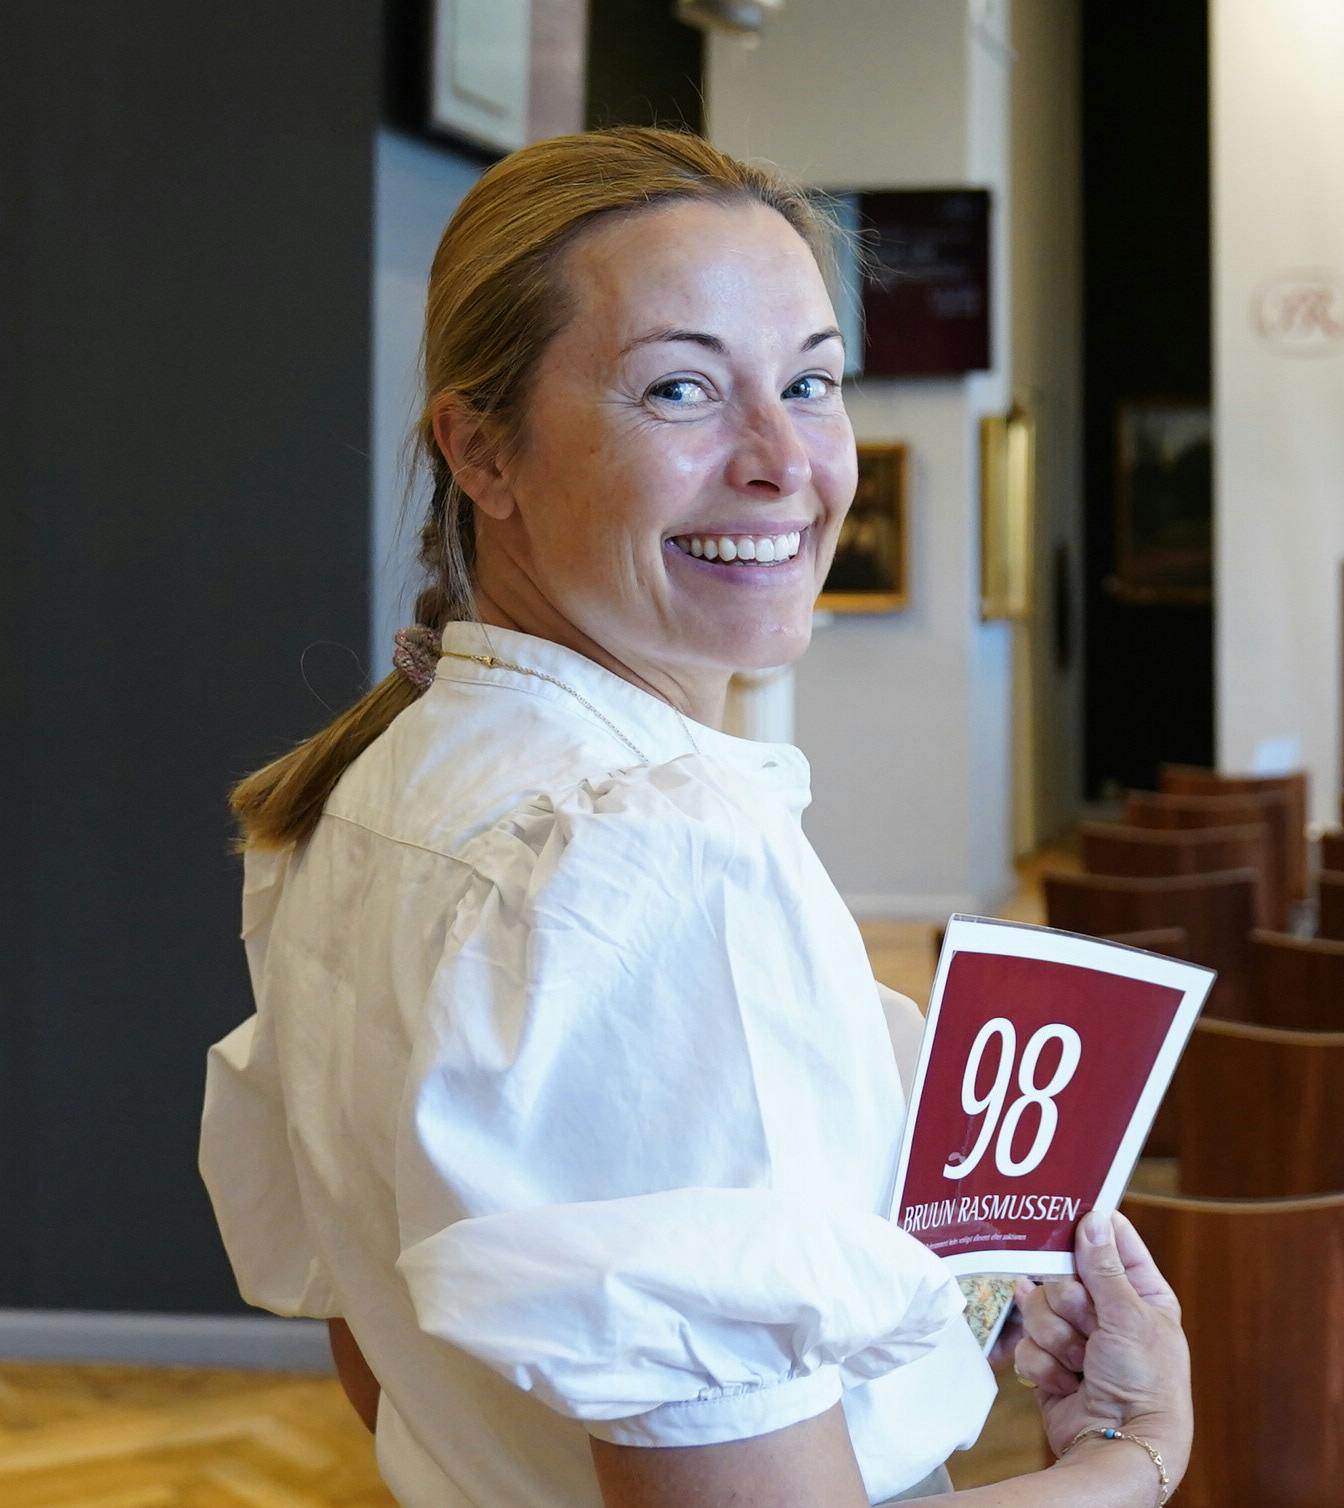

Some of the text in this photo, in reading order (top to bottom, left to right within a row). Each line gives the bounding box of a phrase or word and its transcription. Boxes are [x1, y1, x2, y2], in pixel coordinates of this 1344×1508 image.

[943, 1017, 1082, 1179] 98
[904, 1195, 1081, 1233] BRUUN RASMUSSEN
